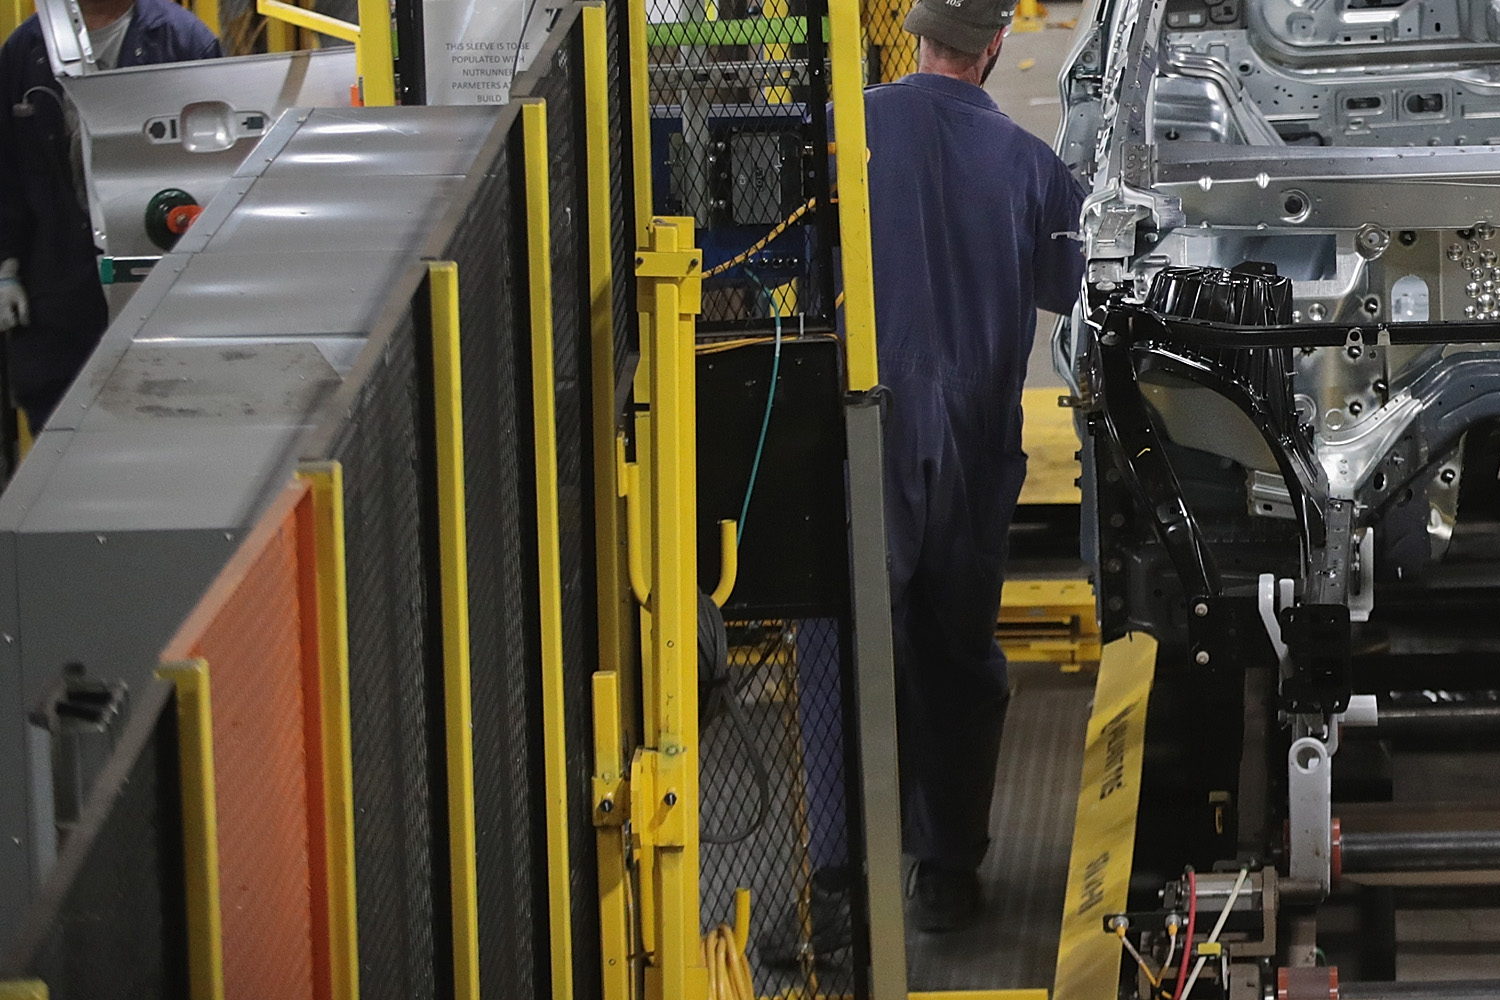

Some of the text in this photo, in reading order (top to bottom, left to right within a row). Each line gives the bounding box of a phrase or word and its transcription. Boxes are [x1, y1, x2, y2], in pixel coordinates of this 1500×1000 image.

[445, 43, 464, 51] THIS
[466, 42, 495, 51] SLEEVE
[497, 42, 504, 51] IS
[506, 42, 518, 51] TO
[452, 55, 525, 64] POPULATED WIH
[452, 82, 501, 90] PARMETERS
[477, 95, 502, 103] BUILD
